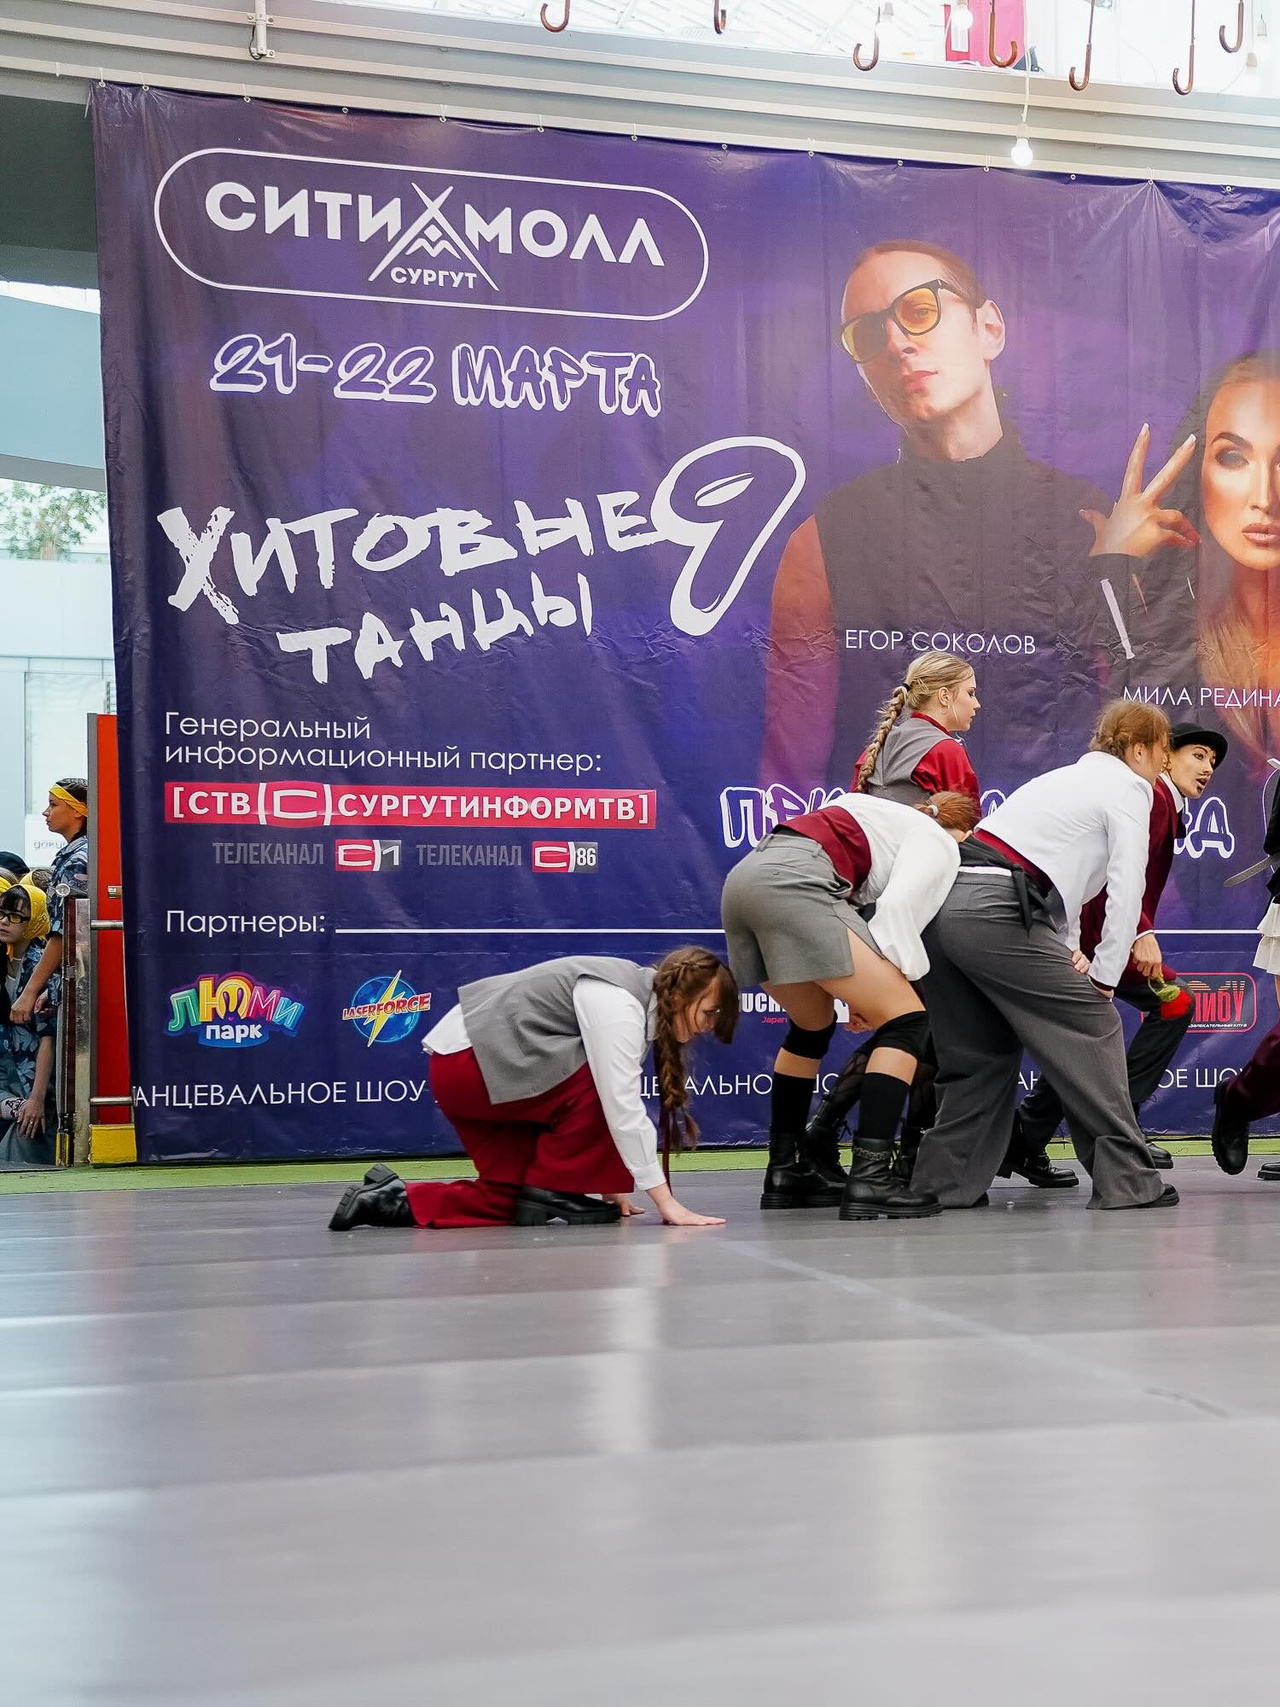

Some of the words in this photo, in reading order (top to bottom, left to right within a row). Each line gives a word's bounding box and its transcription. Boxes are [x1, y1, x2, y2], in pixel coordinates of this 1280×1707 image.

[204, 180, 402, 246] СИТИ
[461, 202, 666, 268] МОЛЛ
[389, 265, 479, 290] СУРГУТ
[210, 333, 438, 403] 21-22
[452, 343, 663, 418] МАРТА
[844, 629, 903, 652] ЕГОР
[911, 630, 1037, 656] СОКОЛОВ
[1122, 685, 1193, 706] МИЛА
[164, 711, 371, 743] Генеральный
[164, 740, 461, 771] информационный
[469, 751, 602, 776] партнер:
[212, 841, 325, 866] ТЕЛЕКАНАЛ
[416, 844, 522, 867] ТЕЛЕКАНАЛ
[165, 909, 326, 938] Партнеры:
[167, 975, 305, 1032] ЛЮМИ
[341, 992, 432, 1021] LASERFORCE
[205, 1023, 263, 1044] парк
[356, 1079, 426, 1103] ШОУ
